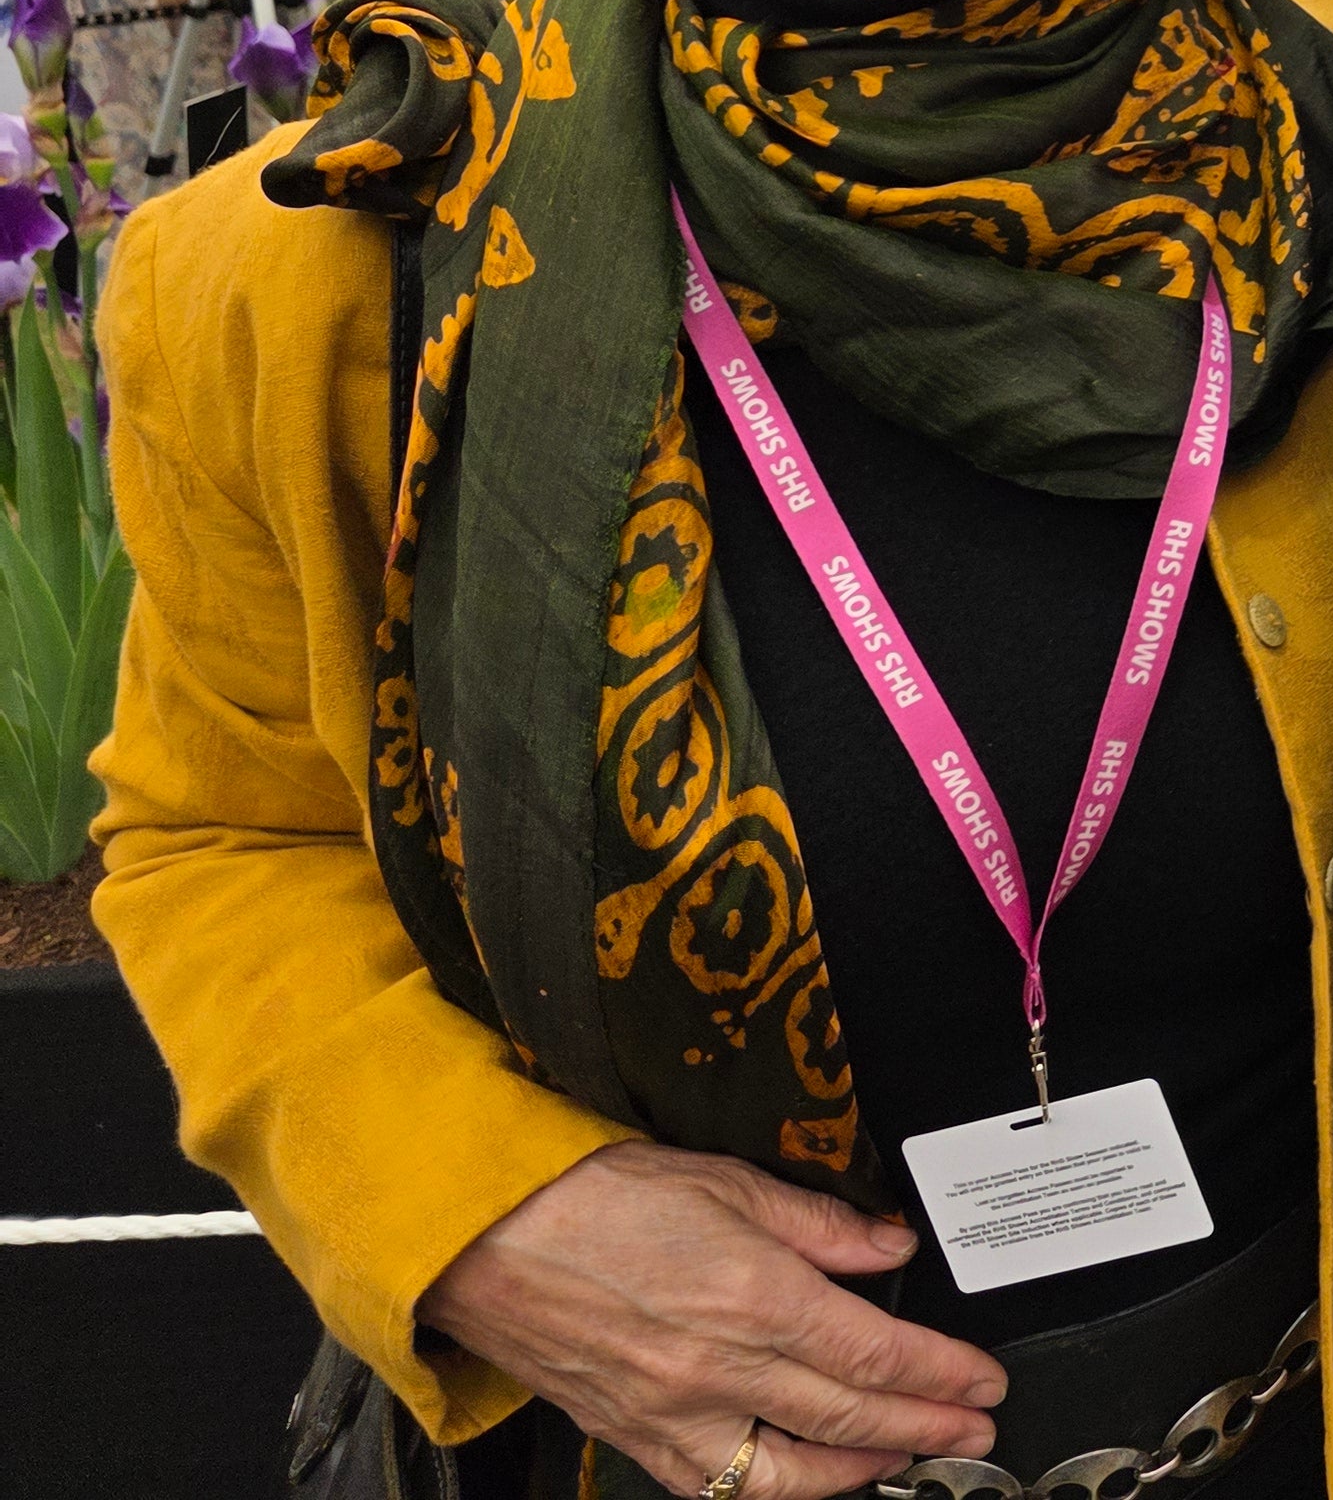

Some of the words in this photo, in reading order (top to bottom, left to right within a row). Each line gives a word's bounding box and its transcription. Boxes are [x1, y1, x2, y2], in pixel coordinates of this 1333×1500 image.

[685, 259, 713, 314] RH
[1210, 312, 1227, 365] RHS
[720, 357, 787, 456] SHOWS
[1189, 366, 1225, 467] SHOWS
[769, 455, 816, 513] RHS
[1156, 519, 1193, 578] RHS
[822, 555, 892, 653] SHOWS
[1126, 581, 1175, 686] SHOWS
[875, 651, 924, 709] RHS
[1092, 740, 1129, 796] RHS
[931, 750, 998, 850] SHOWS
[983, 849, 1019, 906] RHS
[1053, 802, 1106, 904] SHOWS
